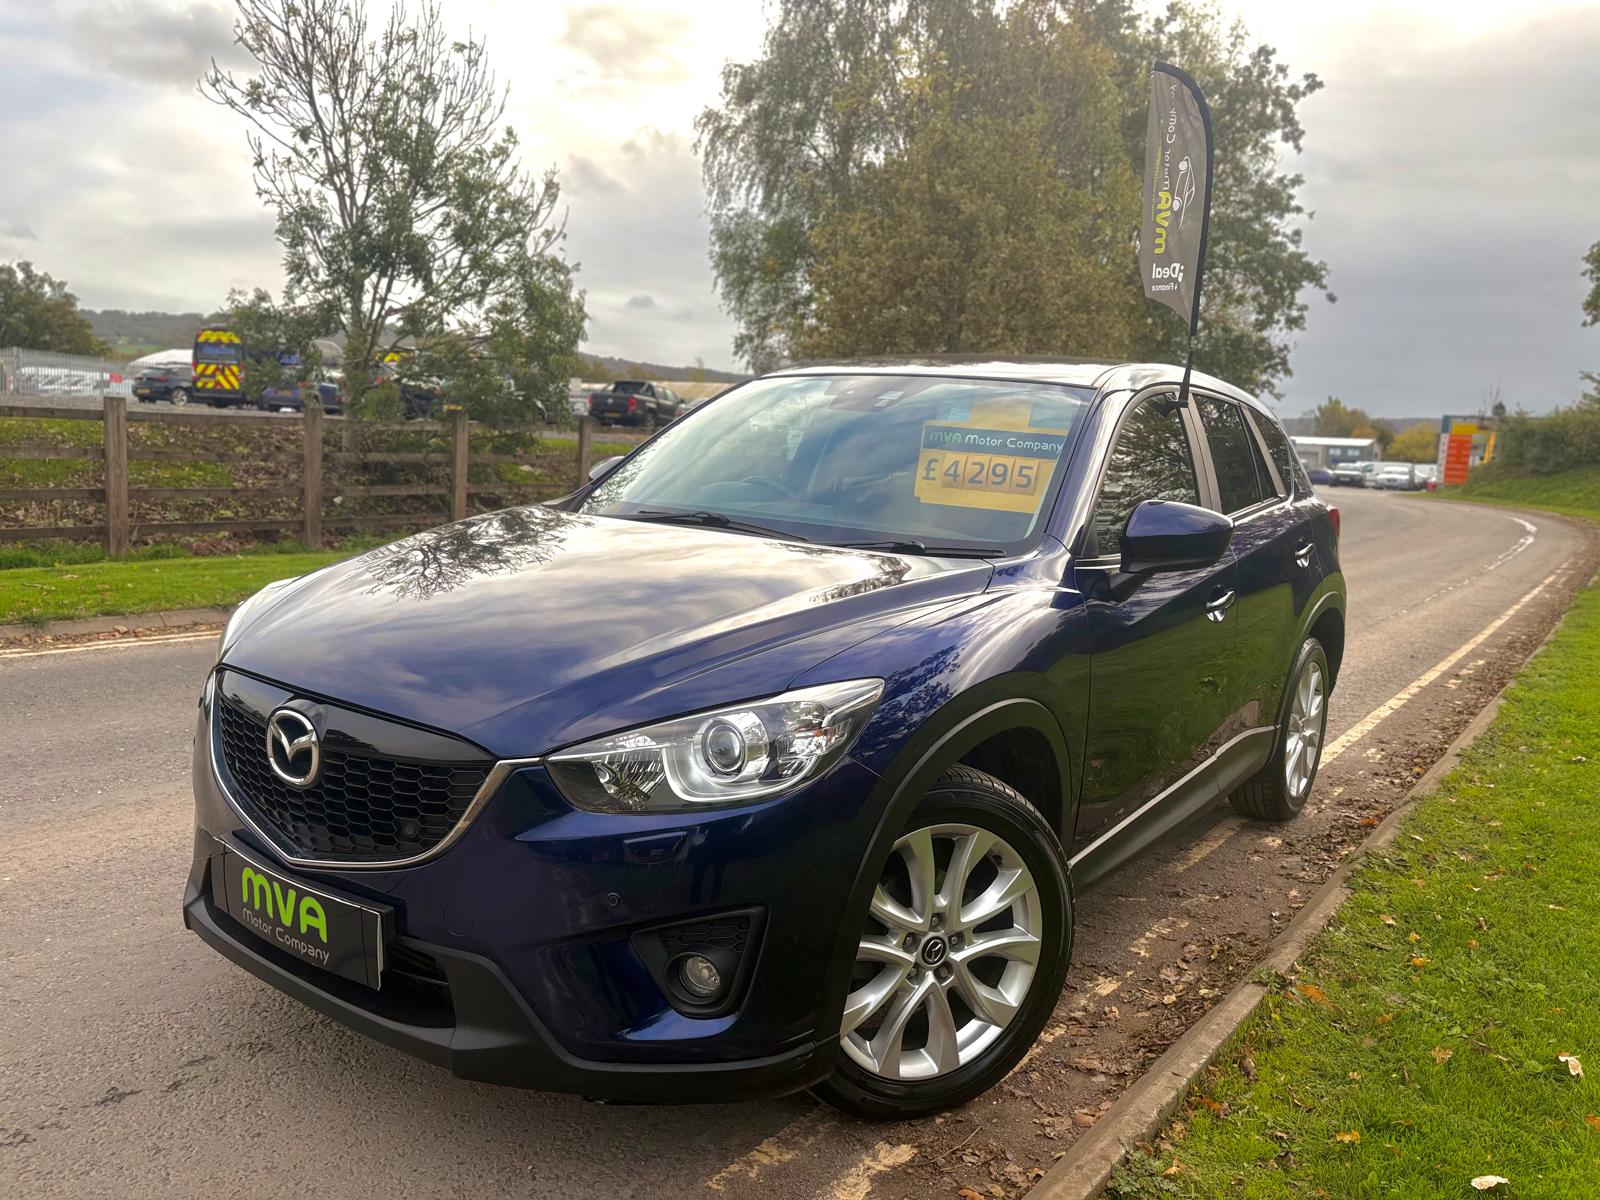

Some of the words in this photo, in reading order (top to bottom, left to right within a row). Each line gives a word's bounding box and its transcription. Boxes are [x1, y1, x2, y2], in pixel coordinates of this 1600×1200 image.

[1006, 437, 1064, 453] Company
[922, 458, 1034, 489] £4295
[275, 928, 330, 965] Company
